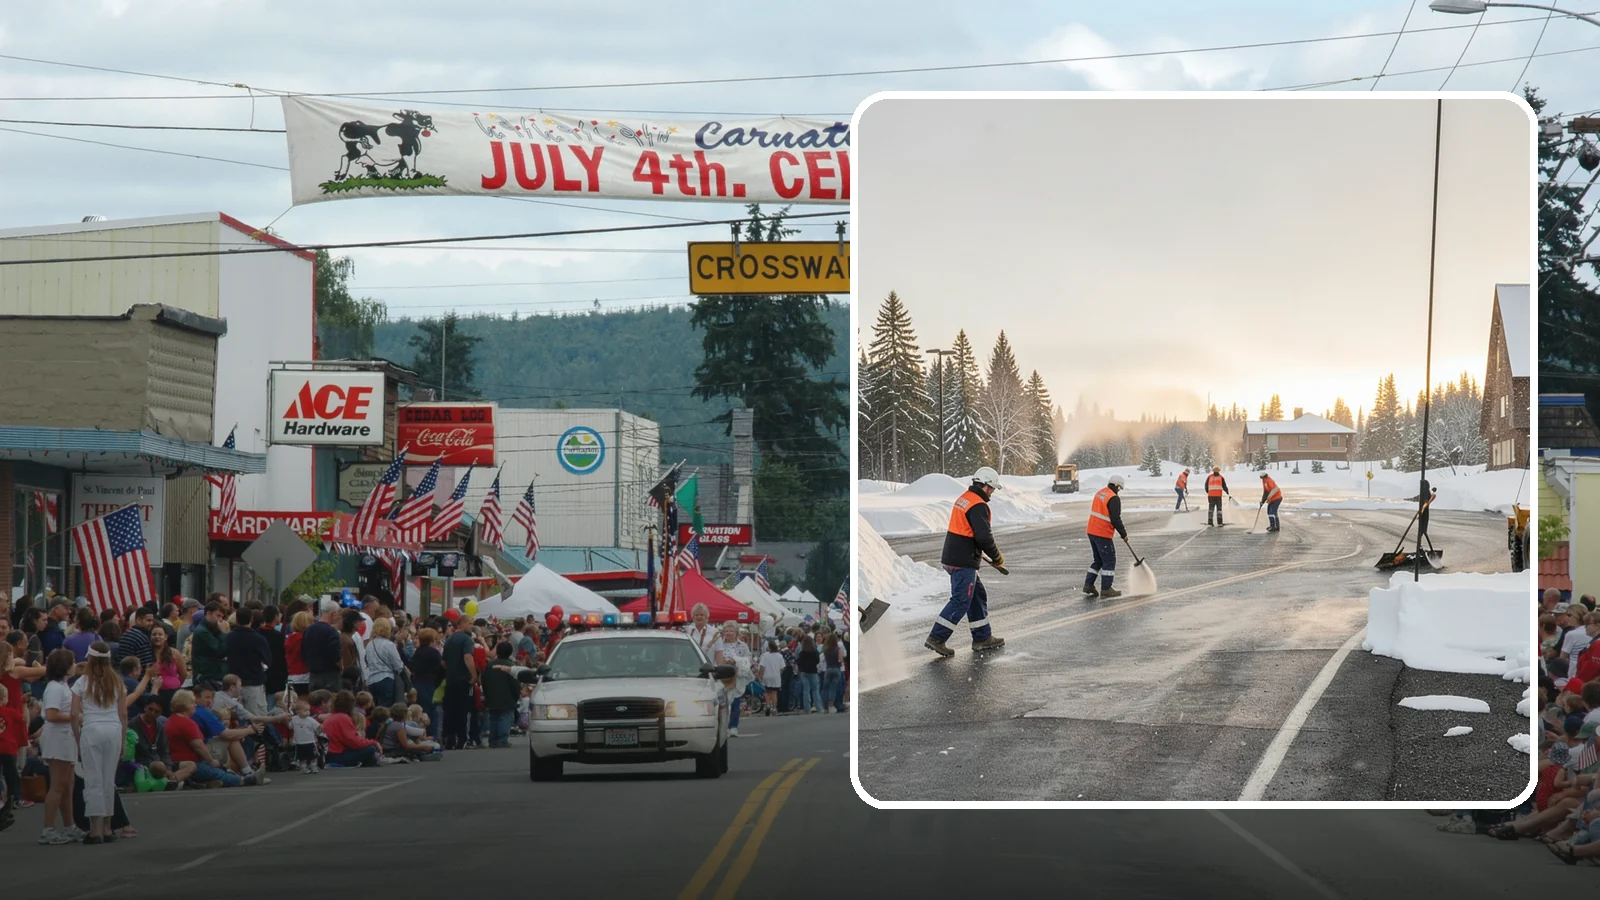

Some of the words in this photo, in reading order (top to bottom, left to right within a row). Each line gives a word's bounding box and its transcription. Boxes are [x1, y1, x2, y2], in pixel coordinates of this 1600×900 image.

[481, 141, 604, 193] JULY
[632, 150, 746, 199] 4th.
[697, 254, 850, 280] CROSSWA
[283, 380, 373, 420] ACE
[406, 409, 452, 422] CEDAR
[283, 421, 371, 436] Hardware
[83, 485, 93, 494] St.
[96, 485, 124, 495] Vincent
[126, 486, 134, 495] de
[138, 486, 155, 495] Paul
[688, 526, 741, 535] CRNATION
[699, 535, 730, 544] GLASS
